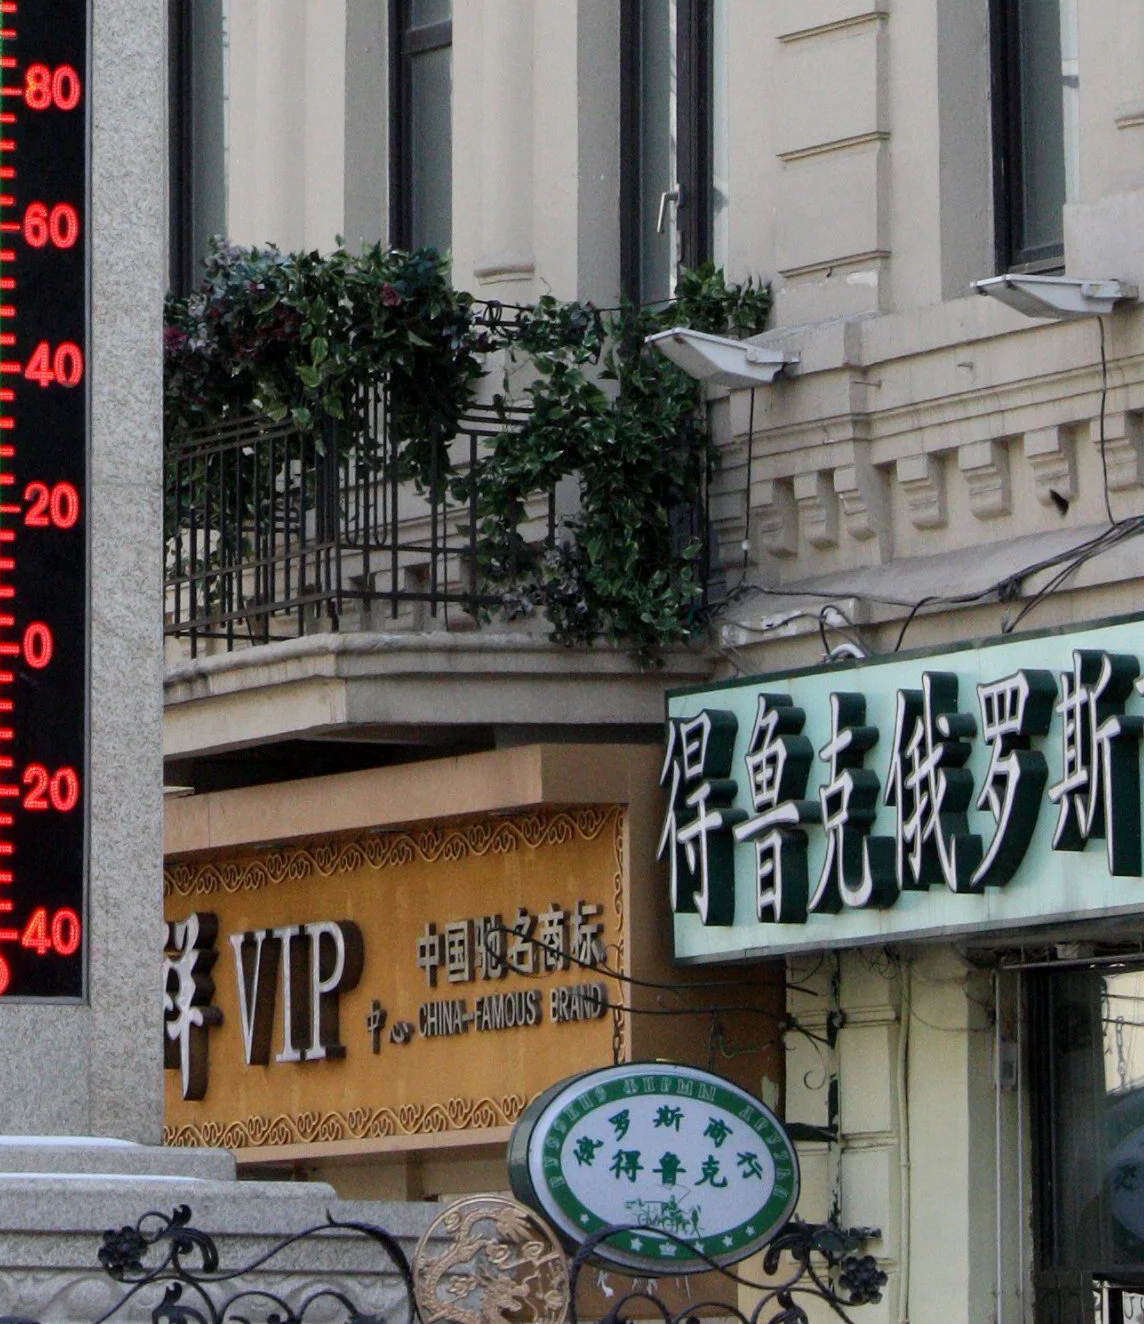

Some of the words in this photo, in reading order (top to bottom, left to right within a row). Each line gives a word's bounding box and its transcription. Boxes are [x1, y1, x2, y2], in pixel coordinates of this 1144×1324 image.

[25, 64, 81, 111] 80
[23, 202, 79, 249] 60
[25, 342, 83, 389] 40
[24, 482, 78, 529] 20
[23, 622, 53, 669] 0
[23, 766, 79, 812] 20
[657, 649, 1144, 927] 得鲁克俄罗斯
[21, 907, 82, 954] 40
[416, 900, 604, 988] 中国驰名商标
[228, 920, 358, 1066] VIP
[550, 982, 607, 1025] BRAND
[366, 1000, 413, 1054] 中心
[573, 1105, 764, 1180] 俄罗斯商行
[609, 1149, 728, 1189] 得鲁克
